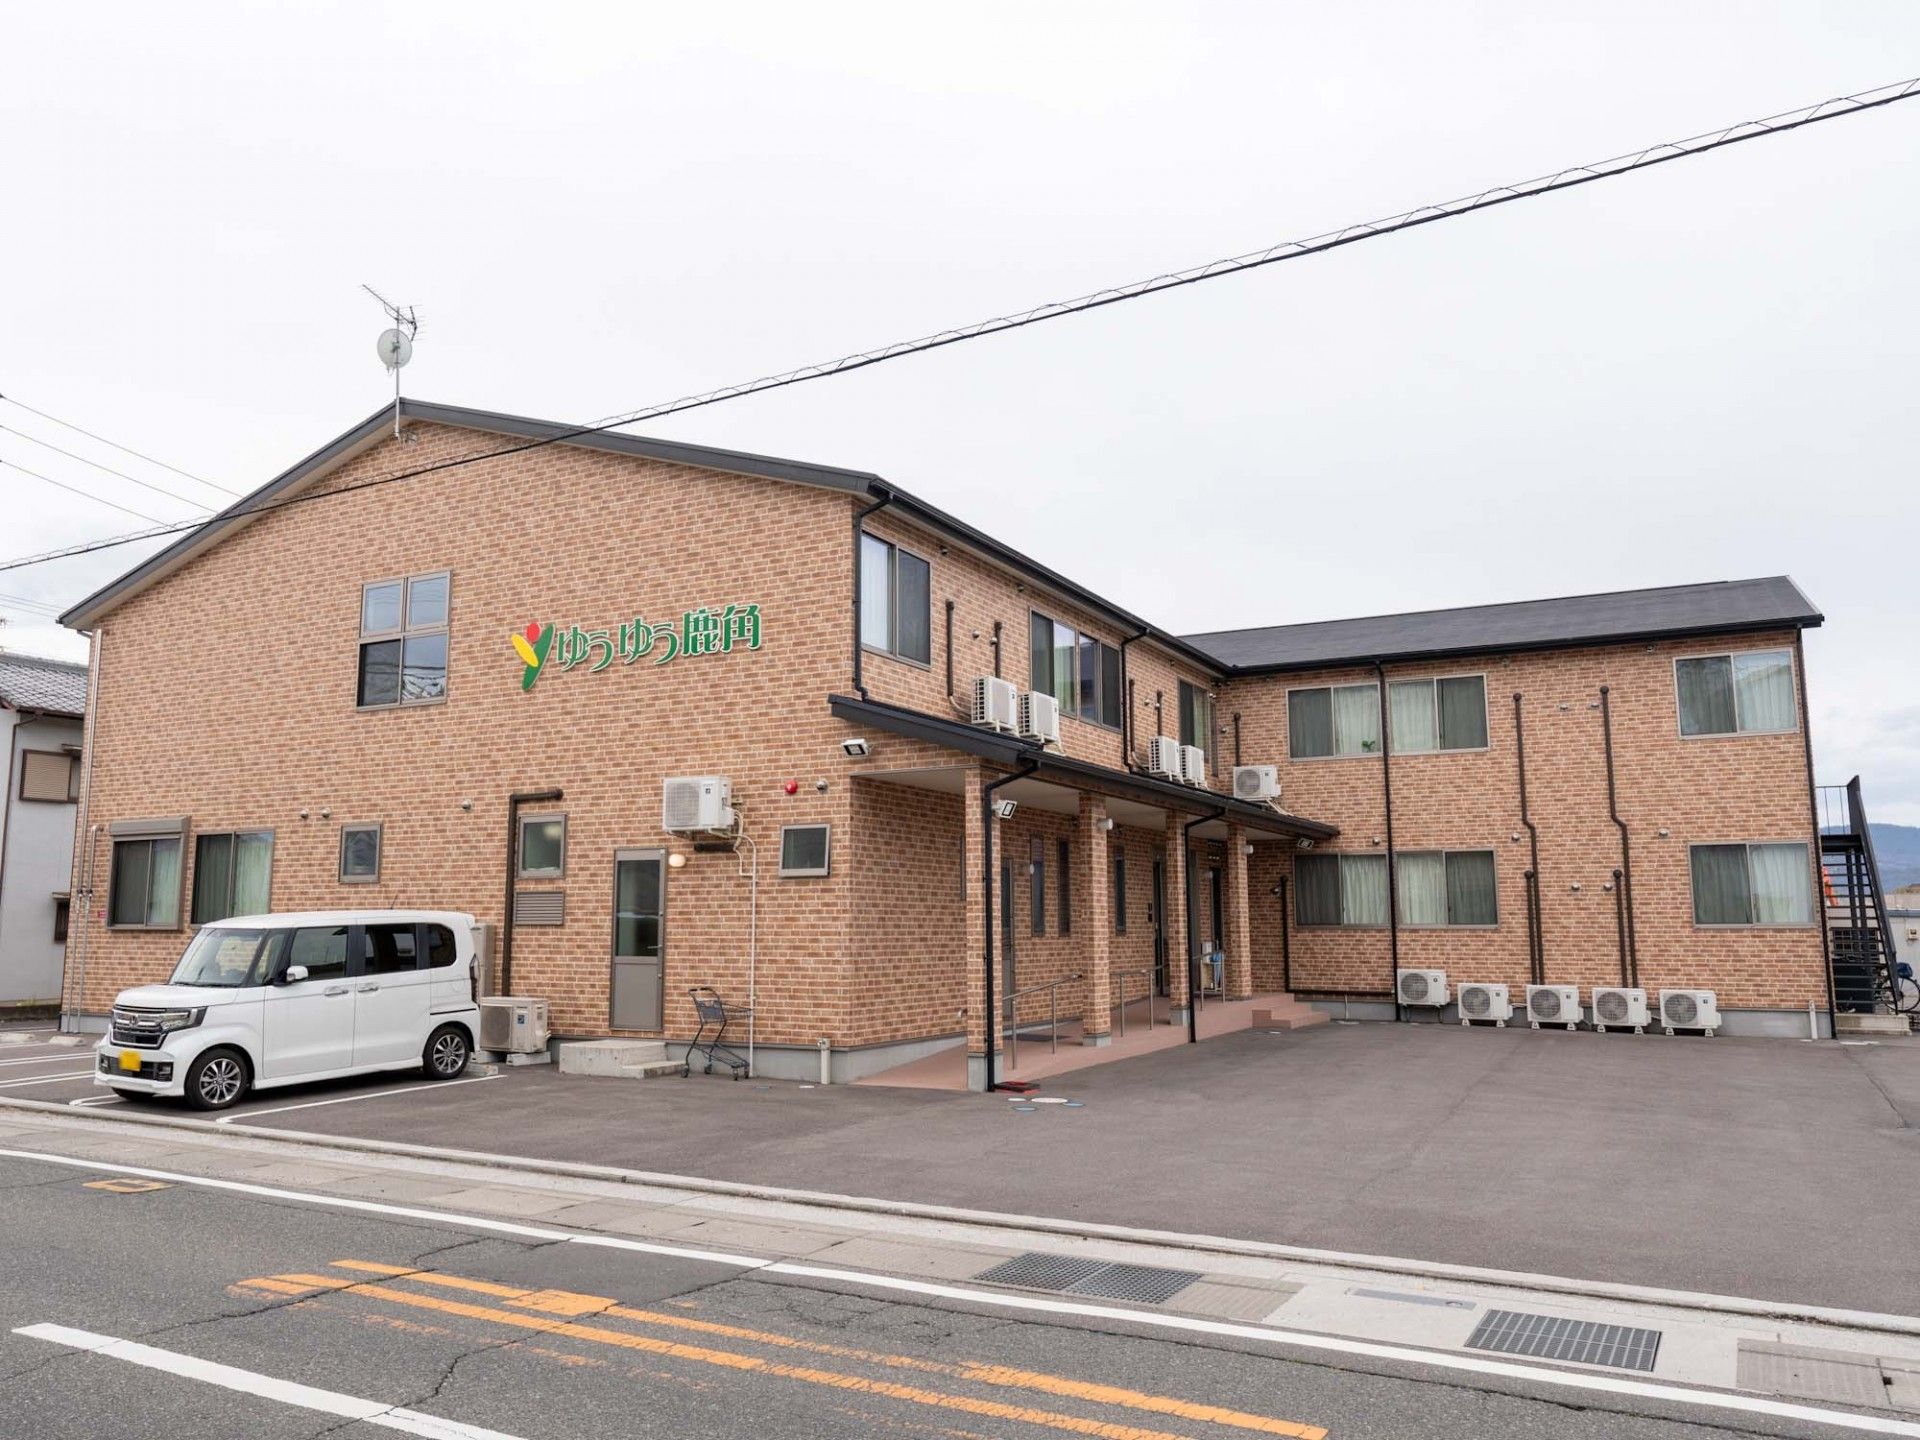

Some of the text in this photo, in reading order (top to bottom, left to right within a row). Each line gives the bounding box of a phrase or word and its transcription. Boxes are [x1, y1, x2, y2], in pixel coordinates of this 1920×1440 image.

[556, 603, 762, 672] ゆうゆう鹿角
